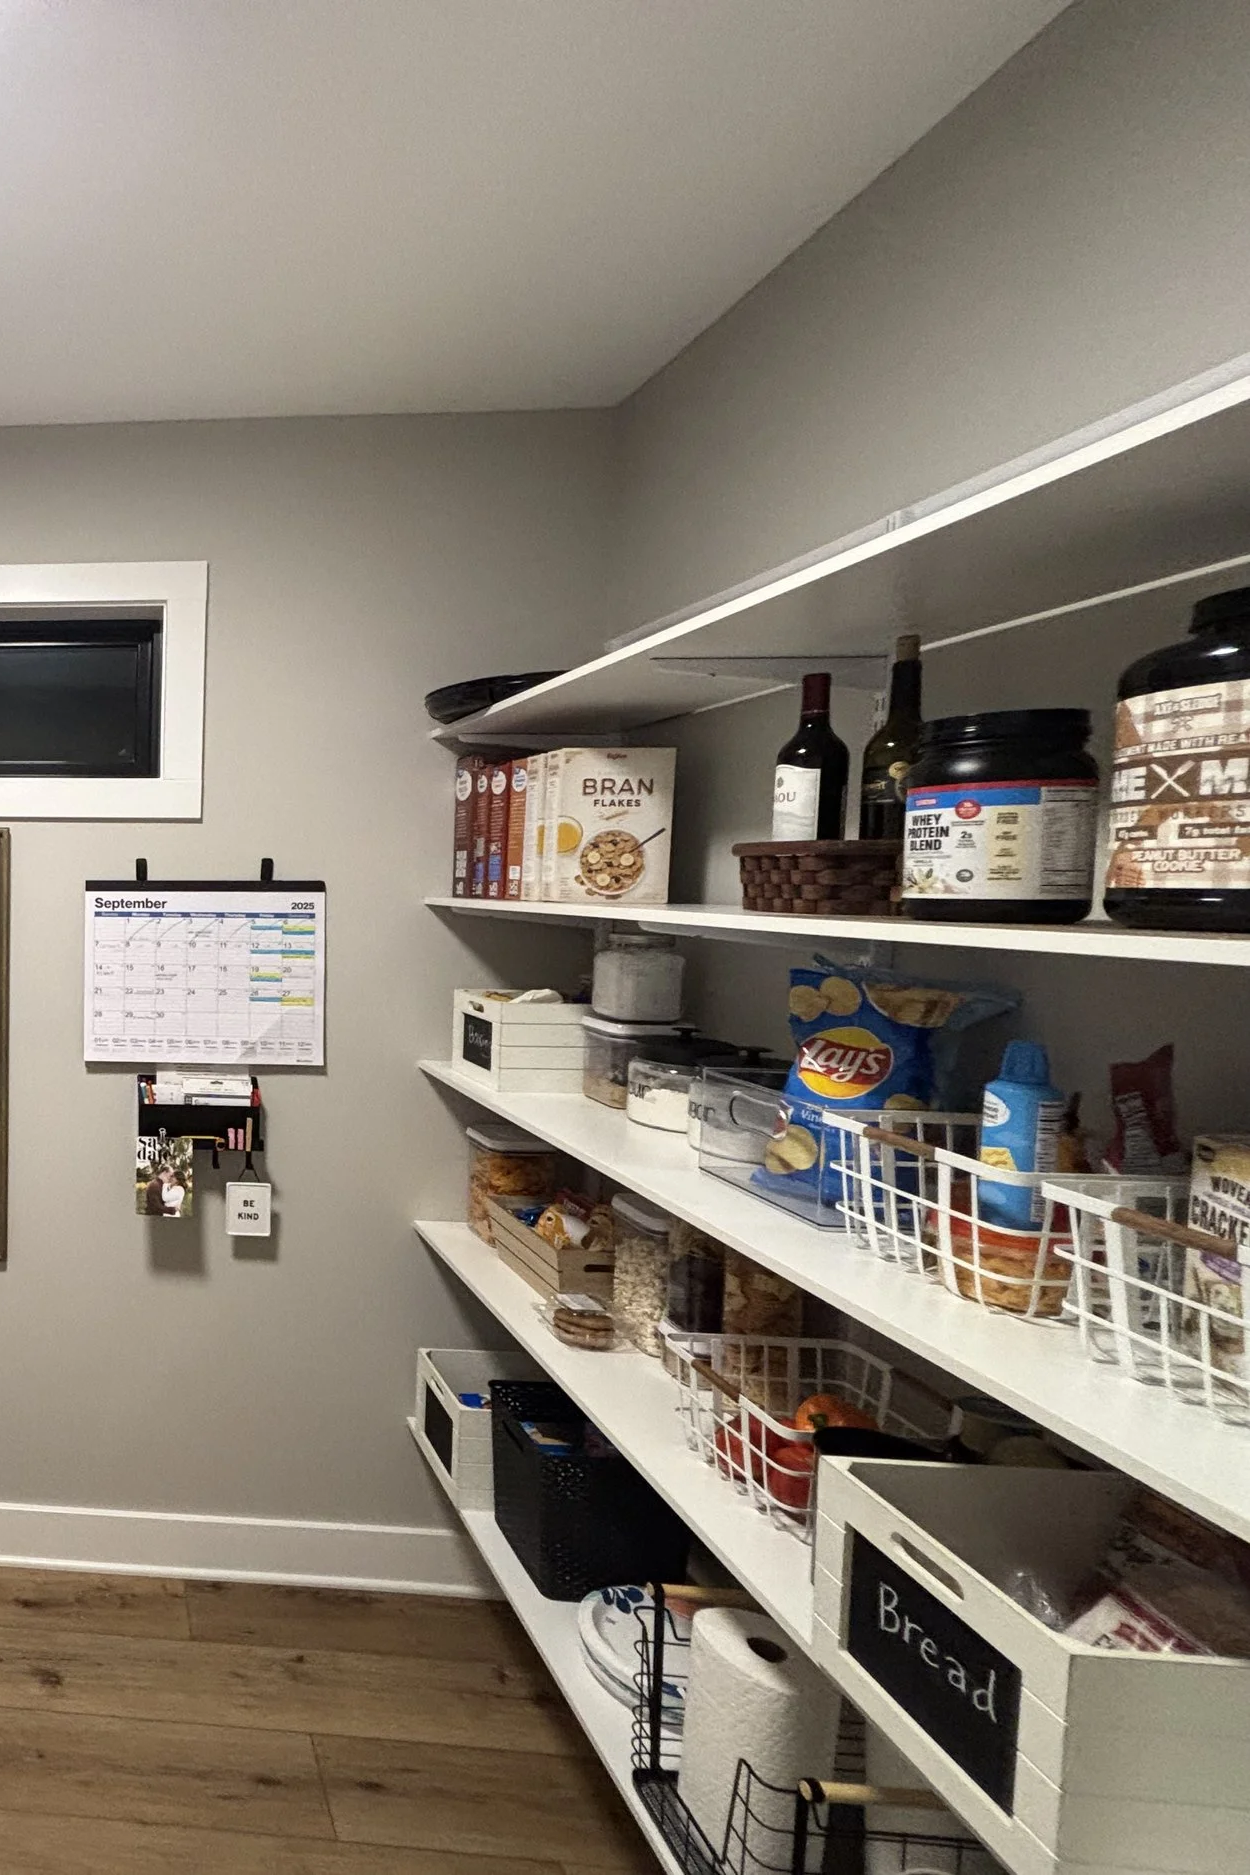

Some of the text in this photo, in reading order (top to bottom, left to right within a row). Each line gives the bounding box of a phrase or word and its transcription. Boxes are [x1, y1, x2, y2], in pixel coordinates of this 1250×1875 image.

[1180, 736, 1215, 749] WITH
[1218, 731, 1250, 745] REA
[582, 778, 654, 796] BRAN
[593, 799, 641, 808] FLAKES
[912, 813, 942, 826] WHEY
[908, 826, 950, 839] PROTEIN
[910, 839, 942, 851] BLEND
[1178, 848, 1241, 861] BUTTER
[95, 898, 315, 910] September 2025
[801, 1040, 887, 1082] Lay's
[243, 1200, 255, 1208] BE
[237, 1213, 260, 1221] KIND
[1190, 1194, 1250, 1247] CRACKE
[879, 1581, 998, 1724] Bread
